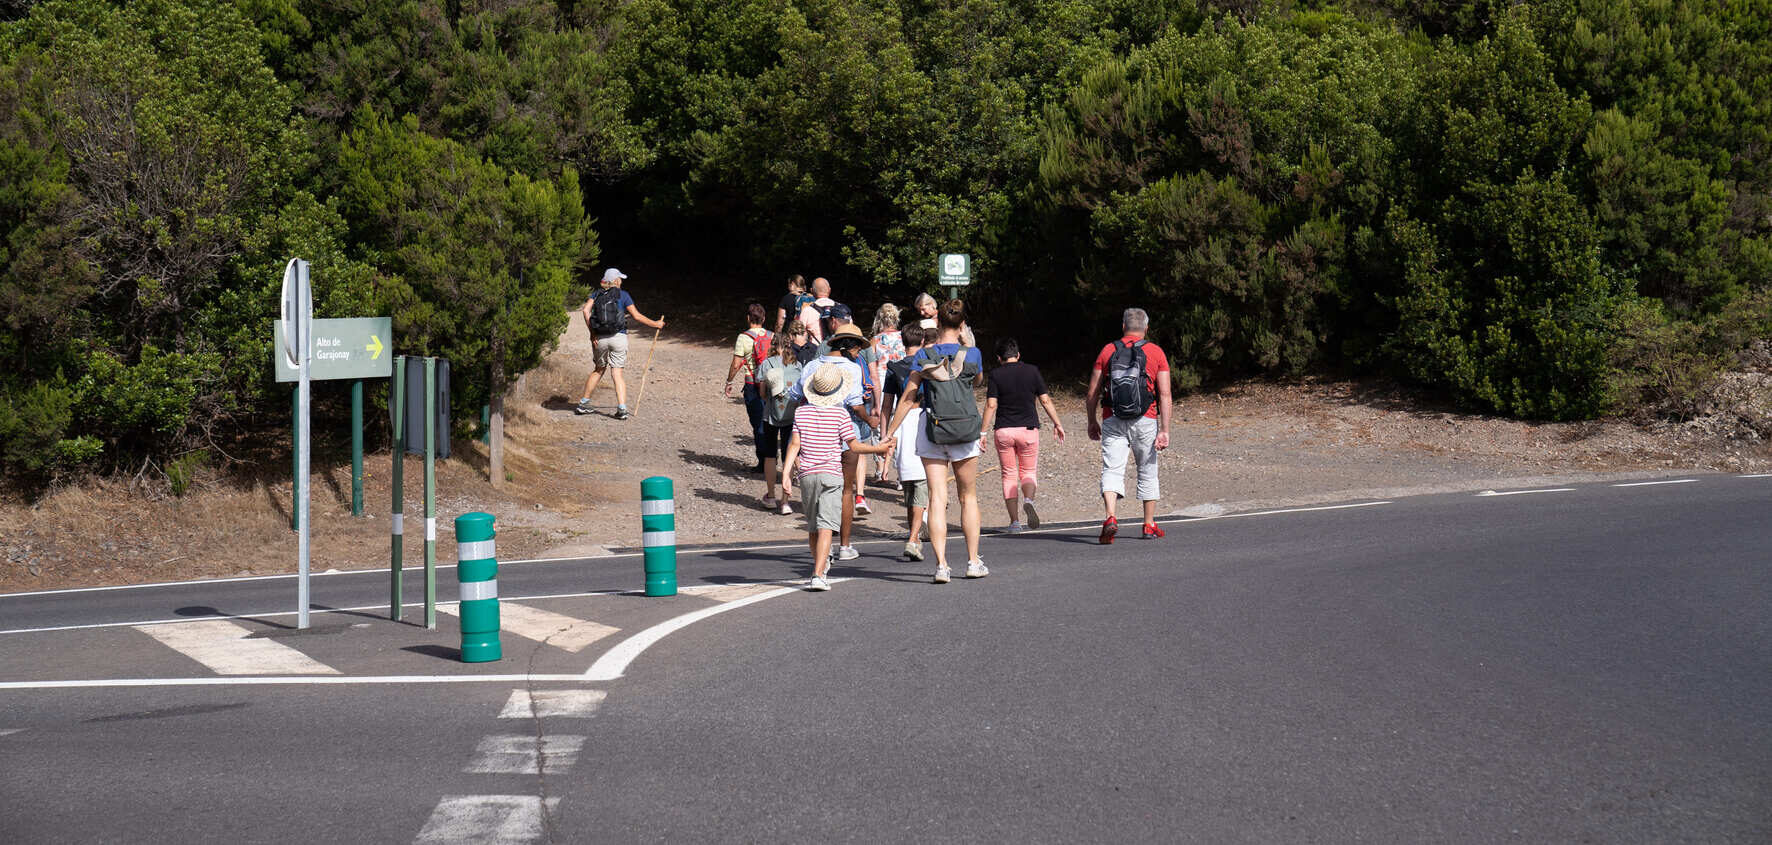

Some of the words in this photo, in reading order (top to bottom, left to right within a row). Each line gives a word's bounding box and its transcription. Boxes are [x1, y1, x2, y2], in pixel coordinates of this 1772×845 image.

[316, 337, 331, 347] Alto
[332, 337, 341, 347] de
[316, 350, 350, 361] Garajonay
